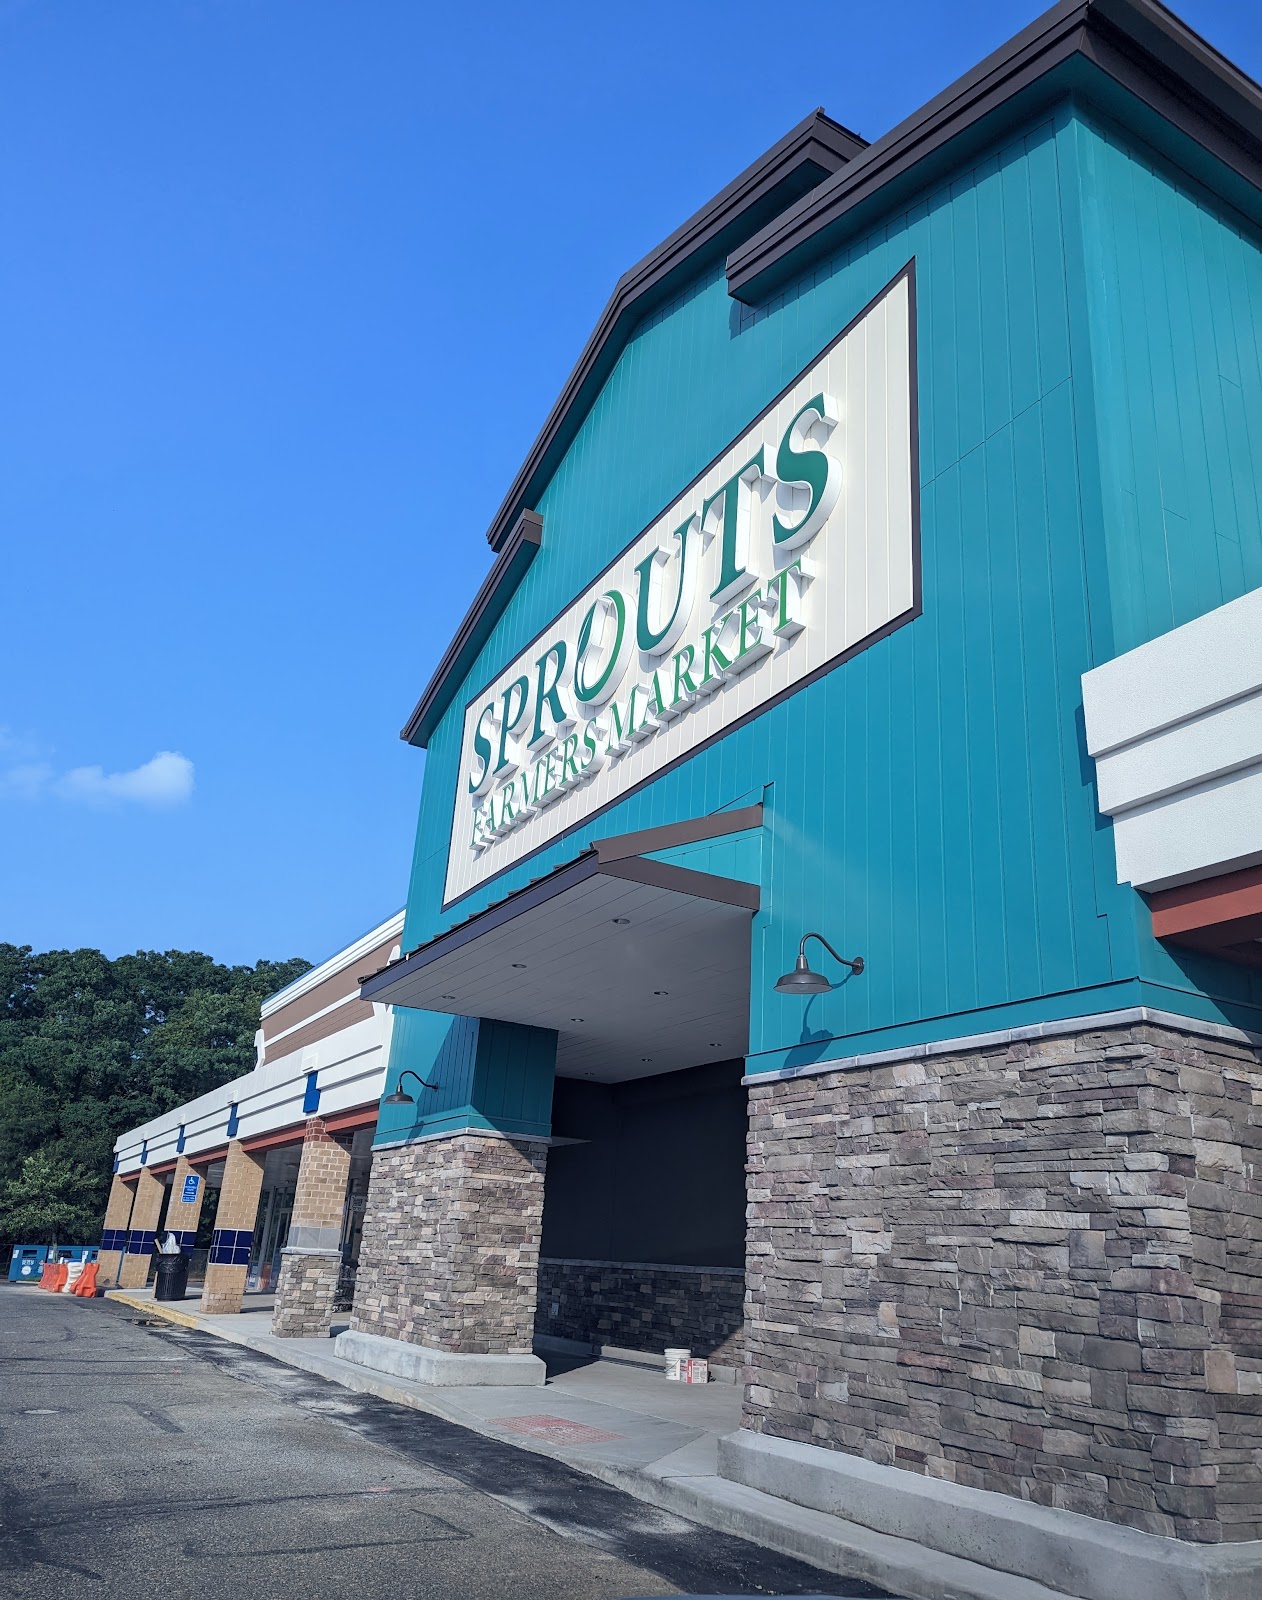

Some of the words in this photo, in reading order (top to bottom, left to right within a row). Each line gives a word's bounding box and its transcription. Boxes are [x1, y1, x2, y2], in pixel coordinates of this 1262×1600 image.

[467, 391, 838, 796] SPROUTS
[469, 717, 602, 850] FARMERS
[605, 558, 809, 755] MARKET
